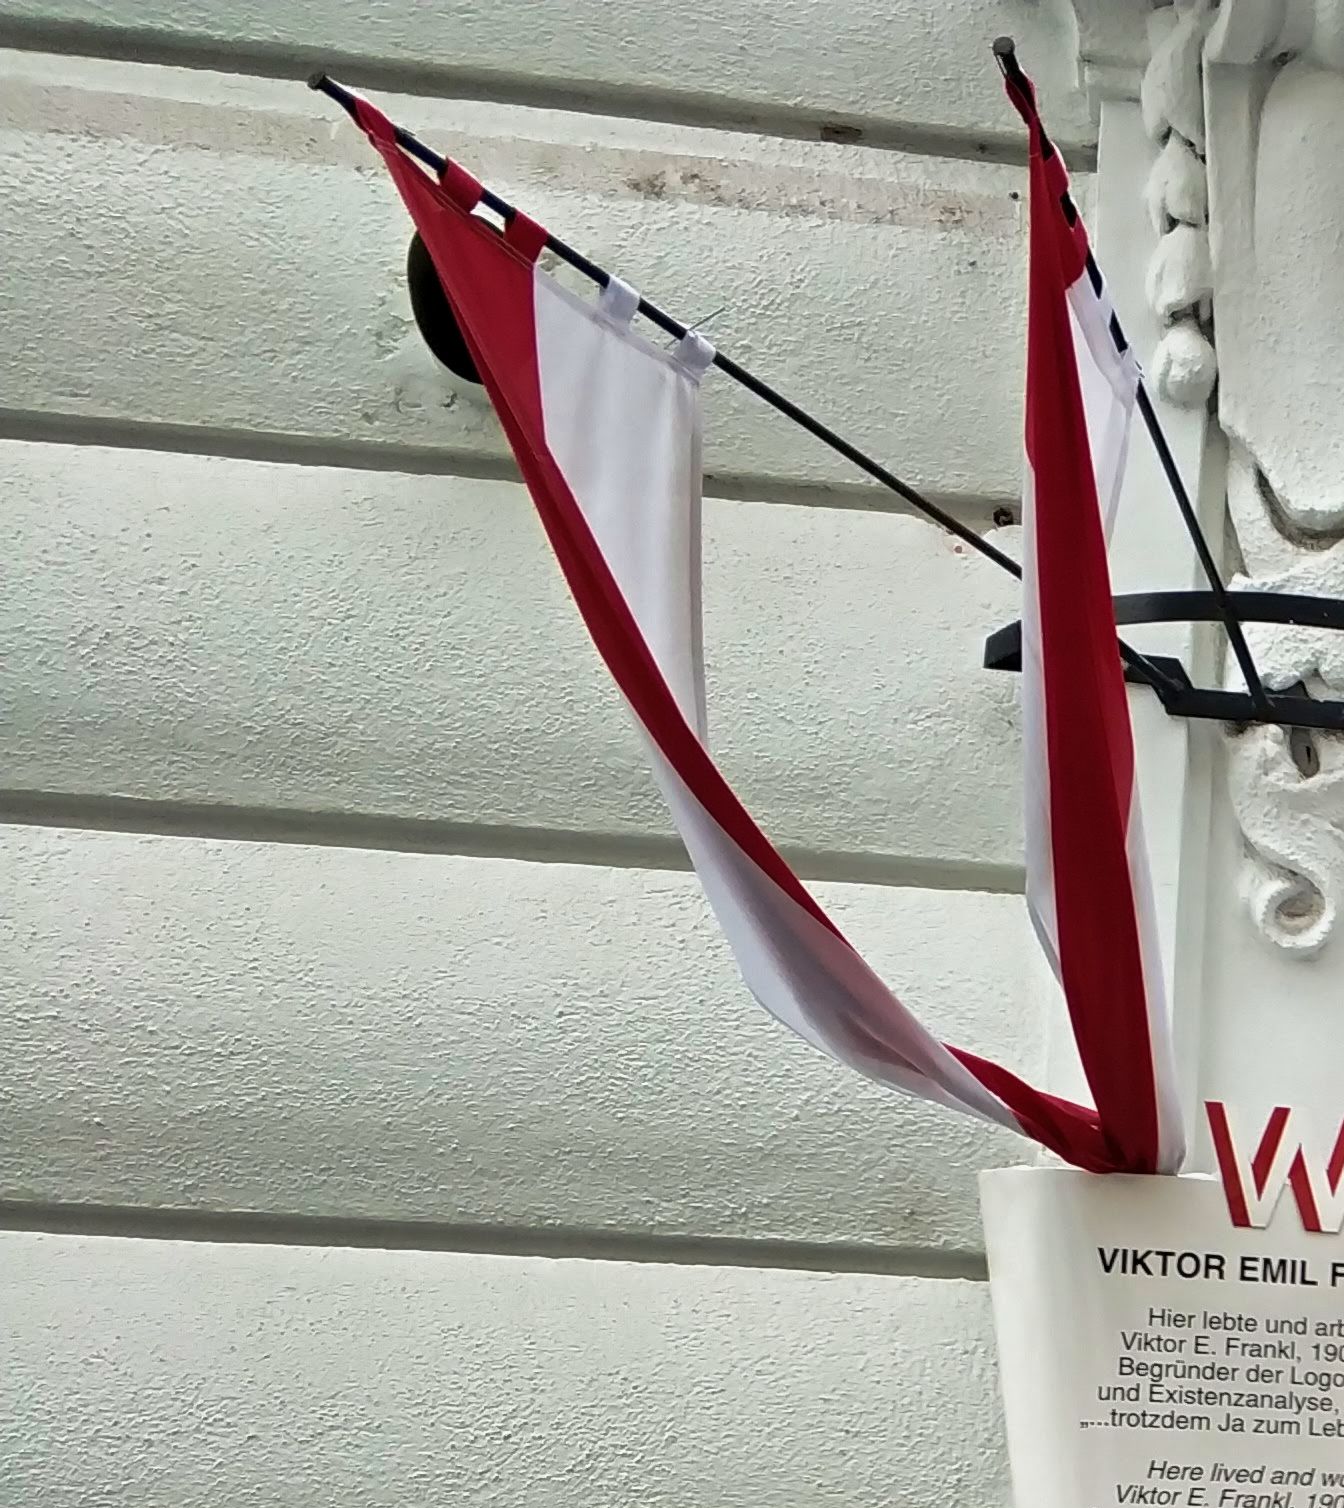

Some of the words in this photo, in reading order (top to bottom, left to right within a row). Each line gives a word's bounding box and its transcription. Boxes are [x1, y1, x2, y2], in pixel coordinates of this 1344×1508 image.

[1098, 1247, 1225, 1280] VIKTOR
[1239, 1256, 1318, 1286] EMIL
[1148, 1308, 1196, 1328] Hier
[1203, 1311, 1258, 1332] lebte
[1266, 1317, 1307, 1335] und
[1121, 1331, 1187, 1353] Viktor
[1194, 1335, 1216, 1355] E.
[1225, 1337, 1301, 1363] Frankl,
[1119, 1357, 1240, 1389] Begründer
[1246, 1364, 1284, 1384] der
[1098, 1383, 1140, 1402] und
[1149, 1383, 1339, 1415] Existenzanalyse,
[1217, 1413, 1245, 1432] Ja
[1252, 1419, 1300, 1435] zum
[1147, 1460, 1204, 1481] Here
[1210, 1463, 1266, 1484] lived
[1270, 1468, 1316, 1486] and
[1117, 1484, 1182, 1505] Viktor
[1187, 1487, 1209, 1506] E.
